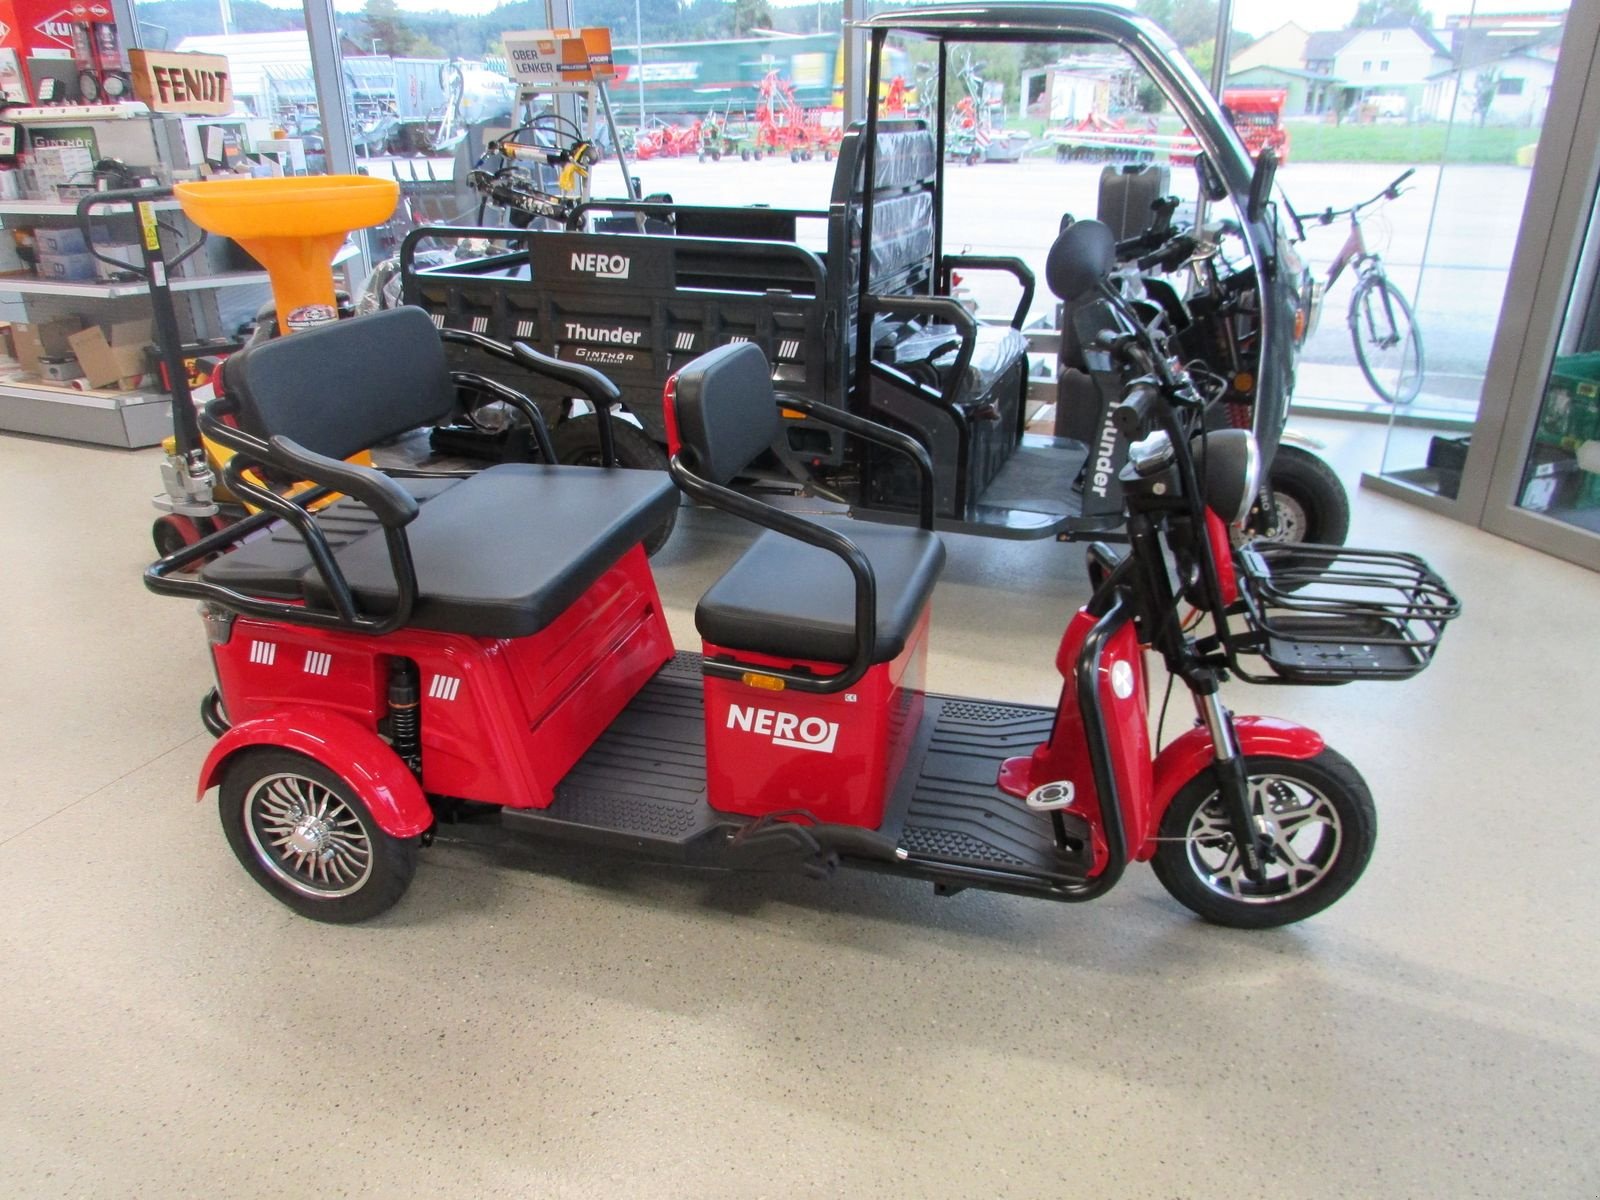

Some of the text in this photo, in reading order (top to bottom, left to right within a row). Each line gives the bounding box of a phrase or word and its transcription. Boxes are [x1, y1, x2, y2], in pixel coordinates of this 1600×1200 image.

[512, 49, 538, 60] OBER
[516, 62, 554, 74] LENKER
[153, 66, 228, 104] FENDT
[570, 252, 630, 279] NERO
[565, 323, 642, 345] Thunder
[726, 703, 839, 753] NERO
